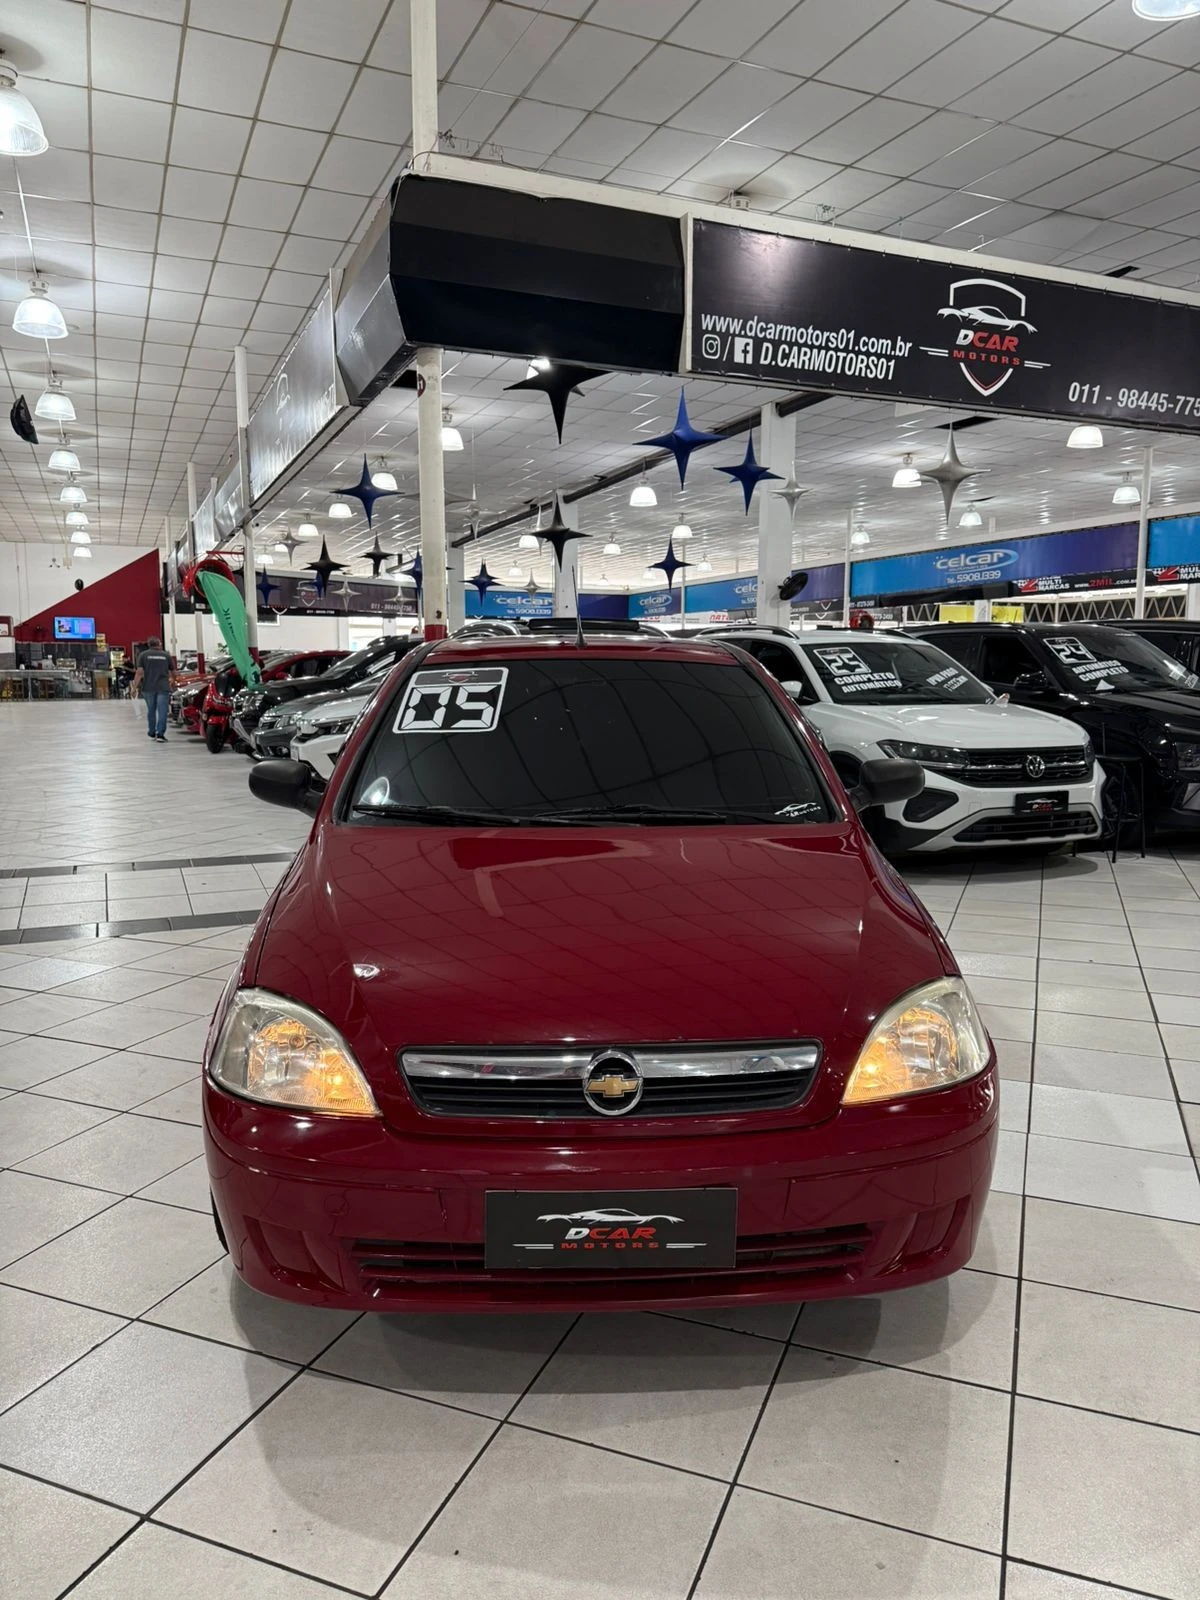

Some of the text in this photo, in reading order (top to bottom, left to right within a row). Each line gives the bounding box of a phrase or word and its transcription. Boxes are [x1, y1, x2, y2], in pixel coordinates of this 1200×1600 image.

[701, 313, 913, 357] www.dcarmotors01.com.br
[955, 328, 1019, 352] DCAR
[759, 342, 896, 381] D.CARMOTORS01
[952, 350, 1021, 366] MOTORS
[1068, 381, 1101, 405] 011
[936, 552, 1005, 570] celcar
[834, 672, 896, 685] COMPLETO
[1078, 666, 1129, 682] COMPLETO
[401, 684, 496, 729] 05
[565, 1227, 657, 1240] DCAR
